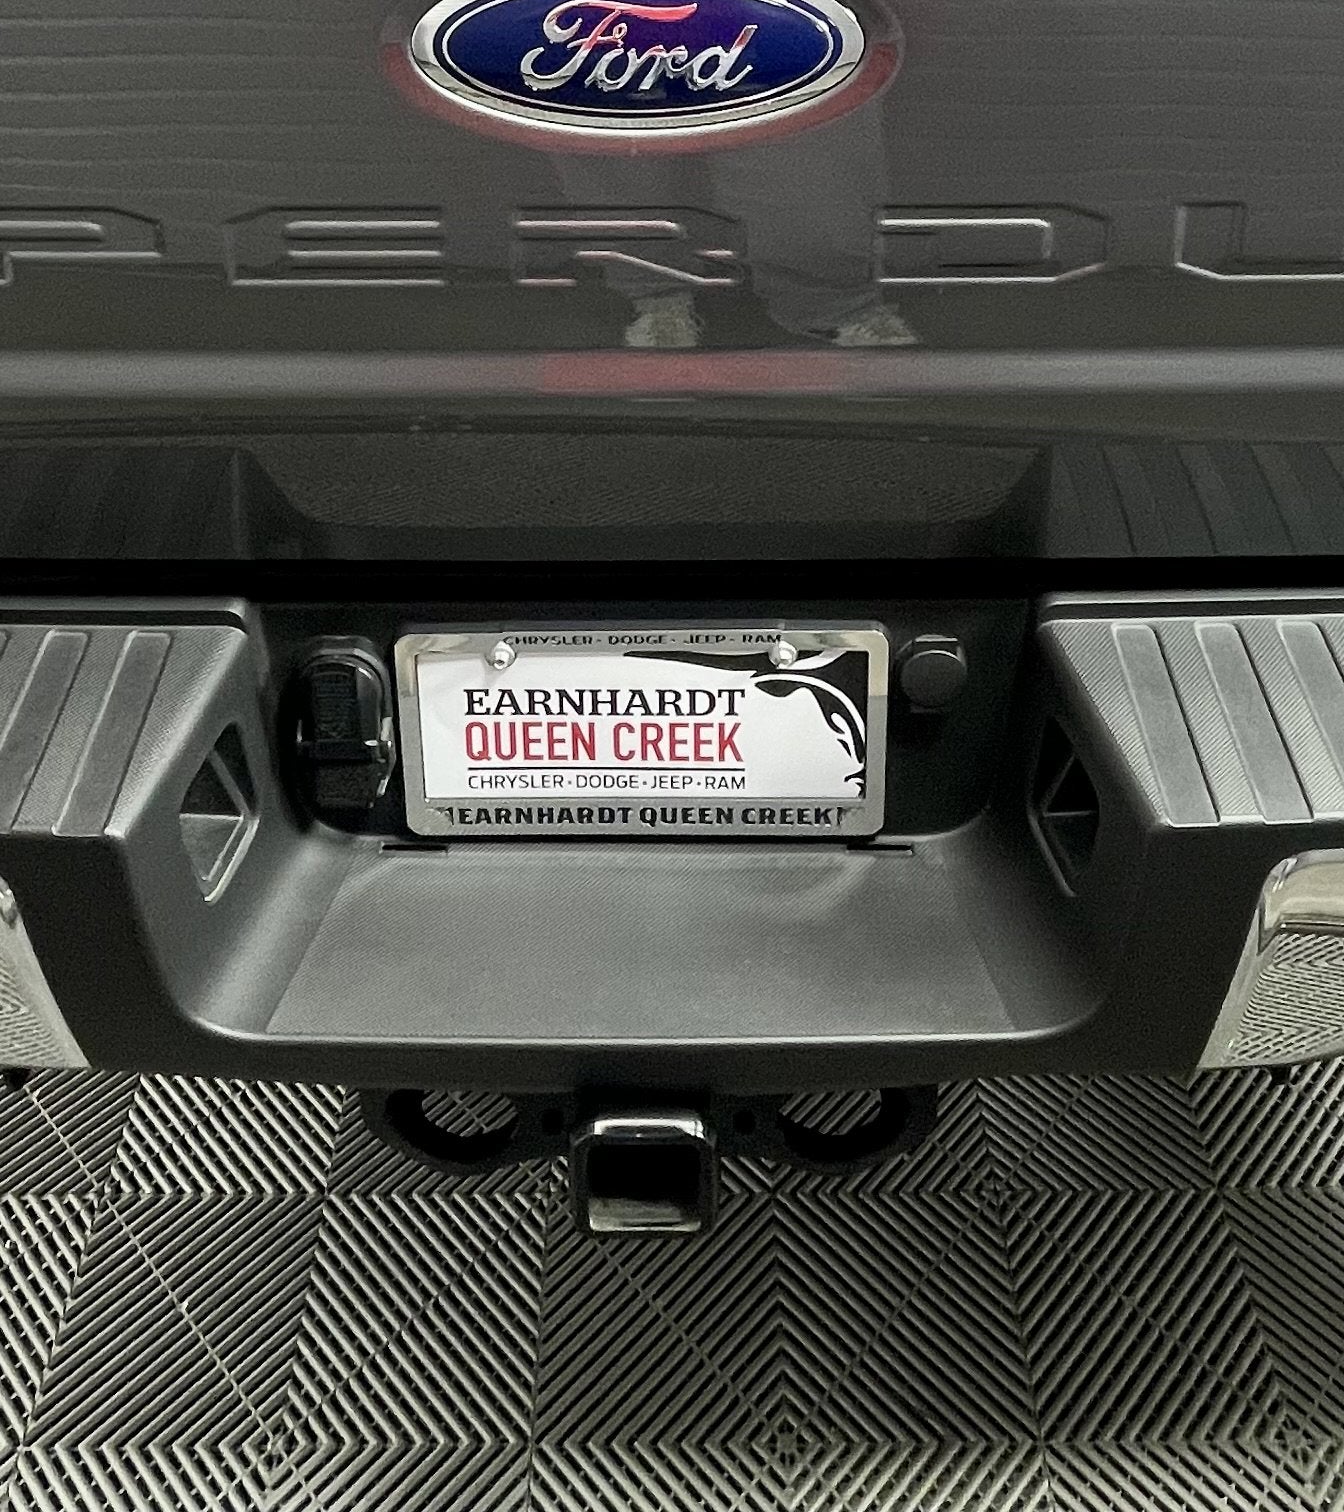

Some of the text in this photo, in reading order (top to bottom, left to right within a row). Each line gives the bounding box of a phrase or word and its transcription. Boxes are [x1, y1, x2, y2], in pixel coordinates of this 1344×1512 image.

[503, 633, 783, 645] CHRYSLER DODGE JEEP RAM
[464, 689, 746, 717] EARNHARDT
[464, 721, 745, 763] QUEEN CREEK
[467, 775, 747, 790] CHRYSLER DODGE JEEP RAM
[458, 806, 832, 827] EARNHARDT QUEEN CREEK
